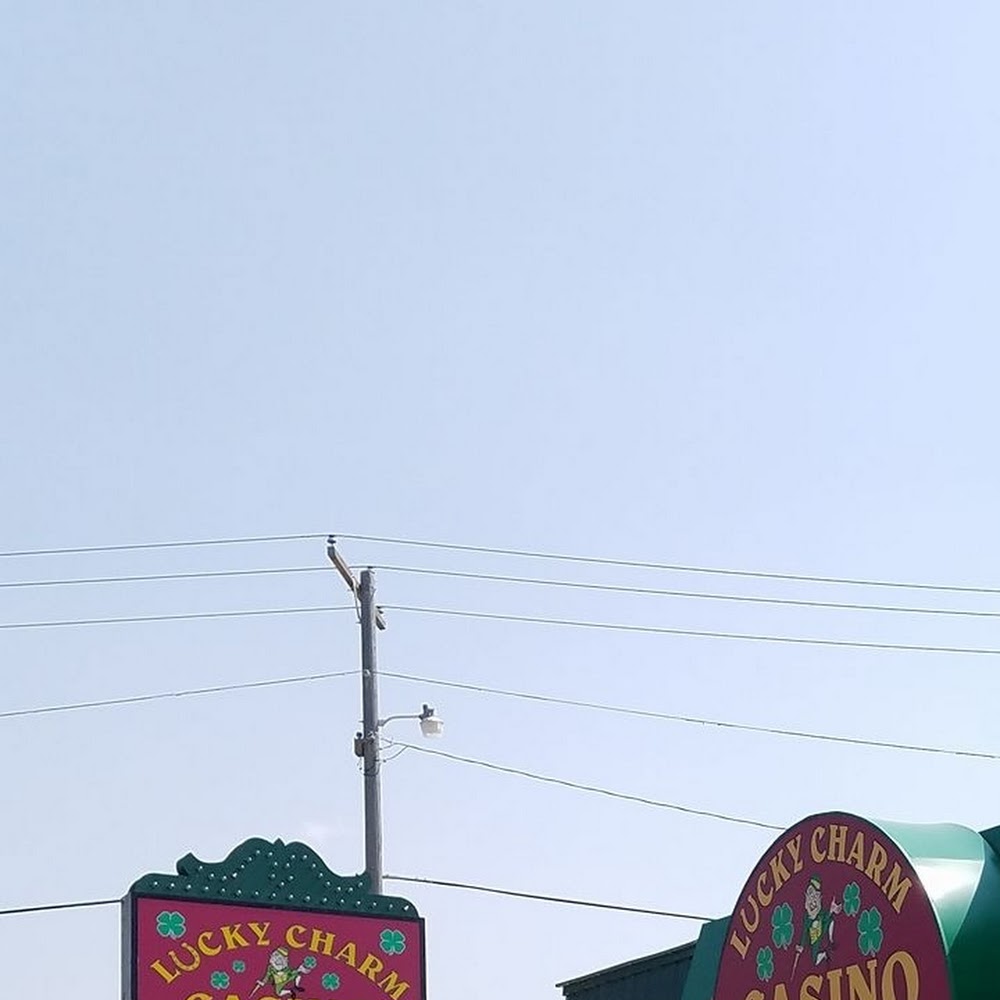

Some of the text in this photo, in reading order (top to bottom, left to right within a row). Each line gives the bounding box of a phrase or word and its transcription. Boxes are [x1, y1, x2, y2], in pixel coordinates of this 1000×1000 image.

[731, 825, 912, 959] LUCKY CHARM
[151, 922, 410, 1000] LUCKY CHARM
